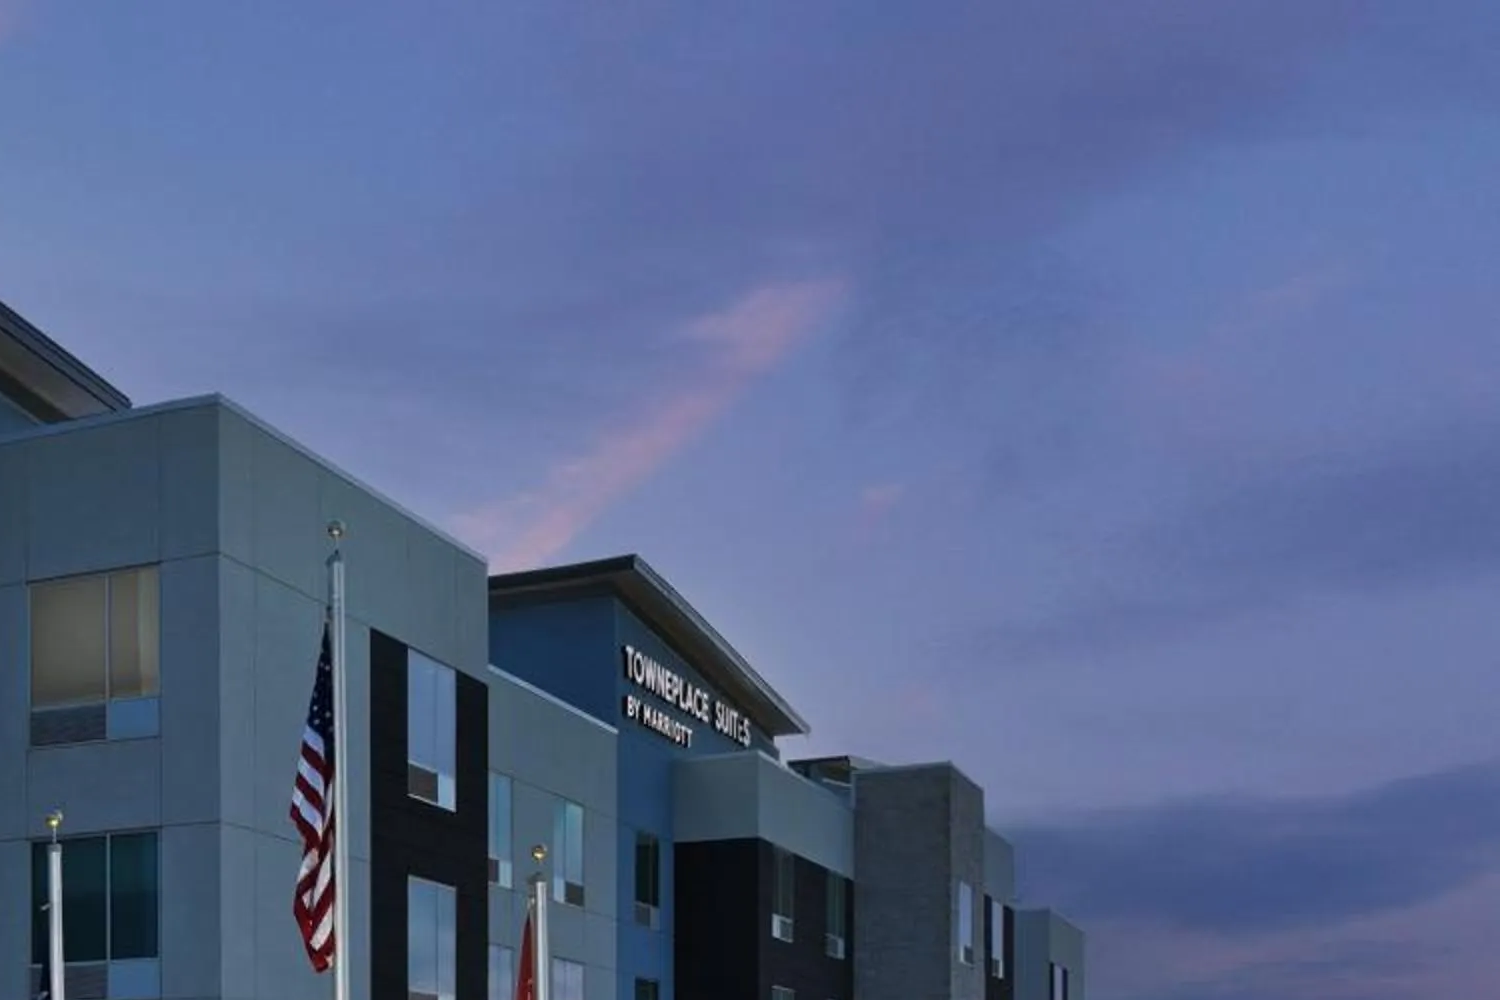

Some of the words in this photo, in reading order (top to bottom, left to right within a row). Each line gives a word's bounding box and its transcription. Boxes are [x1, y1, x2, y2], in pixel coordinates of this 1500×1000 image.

[624, 645, 709, 723] TOWNEPLACE
[714, 700, 751, 748] SUITES
[626, 695, 641, 720] BY
[643, 704, 693, 748] MARRIOTT
